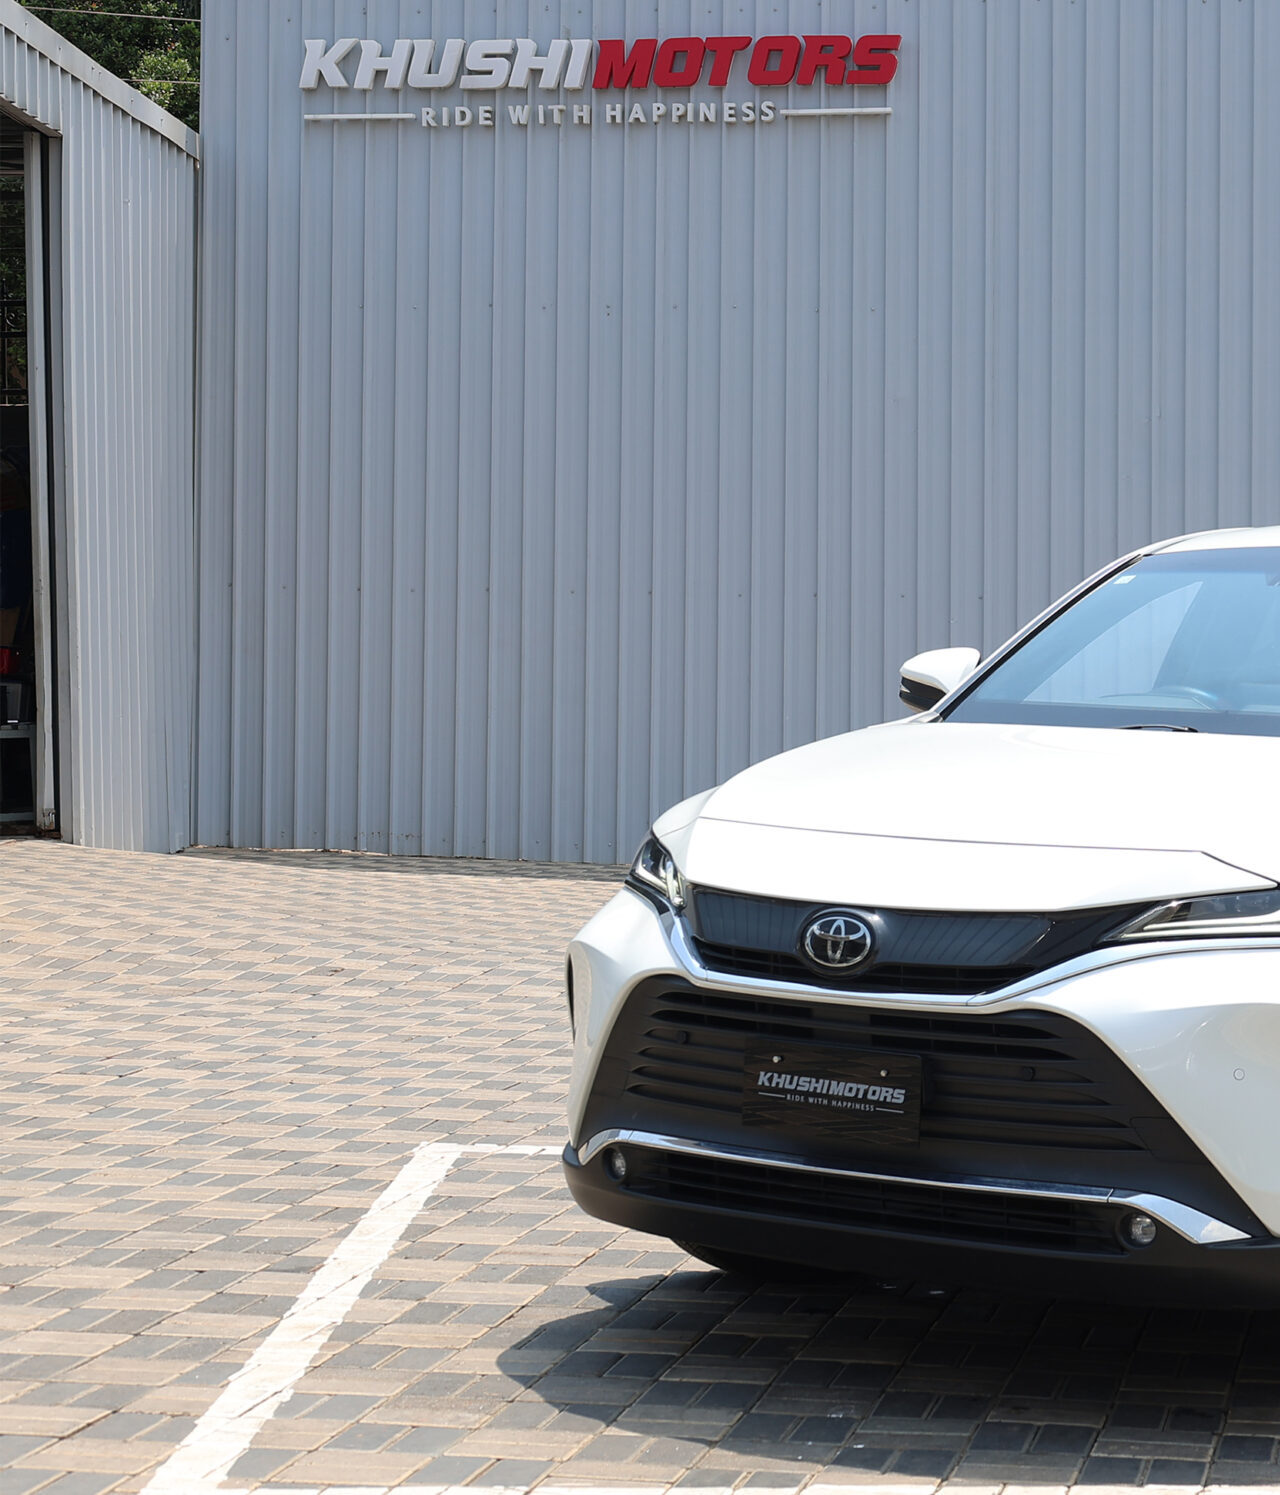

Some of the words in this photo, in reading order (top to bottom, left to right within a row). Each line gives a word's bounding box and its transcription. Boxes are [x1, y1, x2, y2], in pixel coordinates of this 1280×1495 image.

[421, 105, 494, 127] RIDE
[508, 104, 592, 126] WITH
[605, 101, 777, 123] HAPPINESS
[786, 1093, 805, 1103] RIDE
[808, 1096, 829, 1106] WITH
[831, 1099, 875, 1112] HAPPINESS
